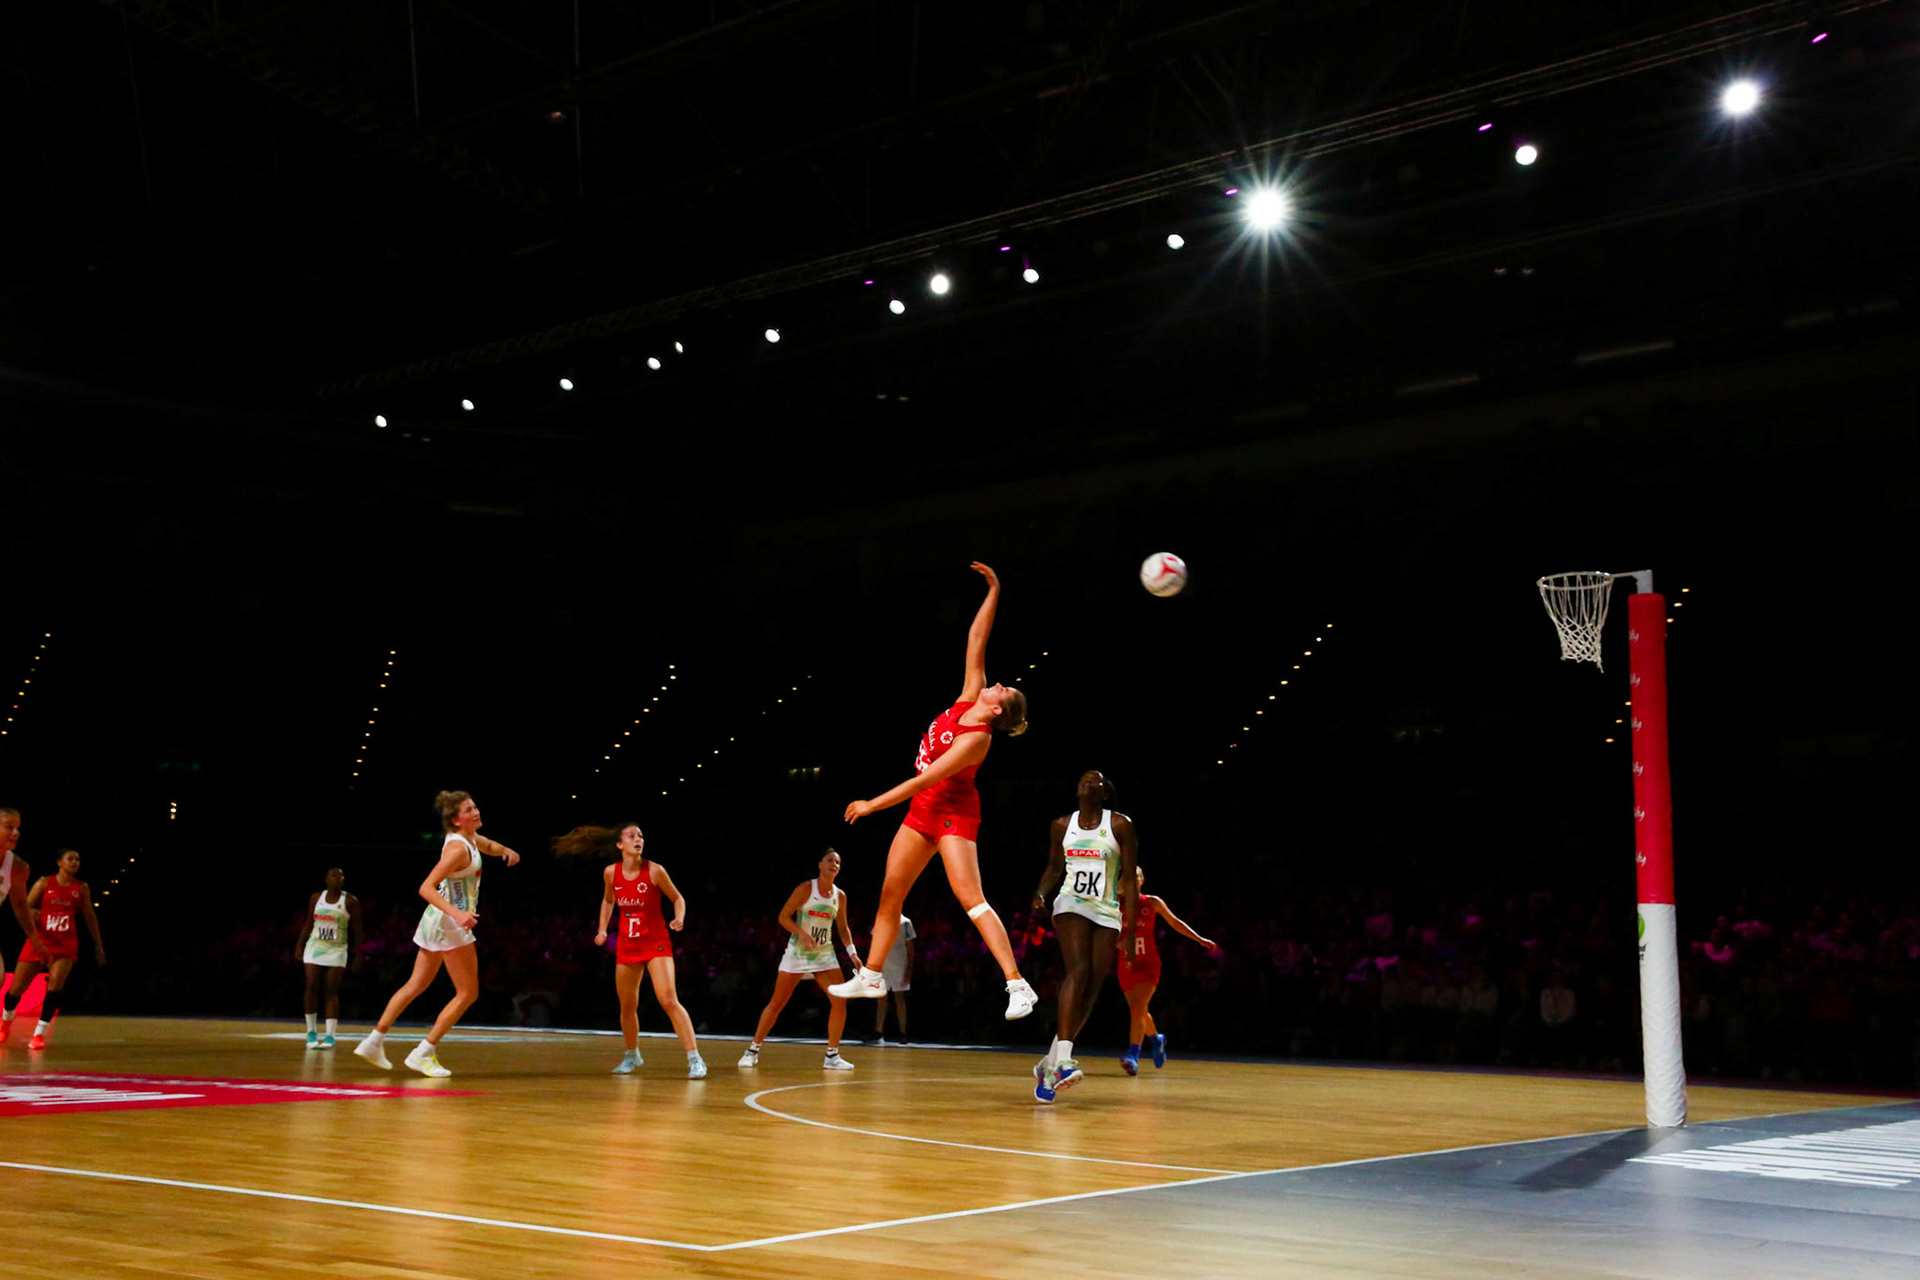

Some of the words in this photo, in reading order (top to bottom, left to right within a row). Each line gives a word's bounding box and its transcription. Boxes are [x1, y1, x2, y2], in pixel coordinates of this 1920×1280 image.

[1073, 870, 1102, 897] GK
[453, 881, 465, 911] elkom
[318, 926, 335, 940] WA
[628, 917, 641, 938] C
[811, 926, 828, 945] WD
[1135, 937, 1146, 955] A
